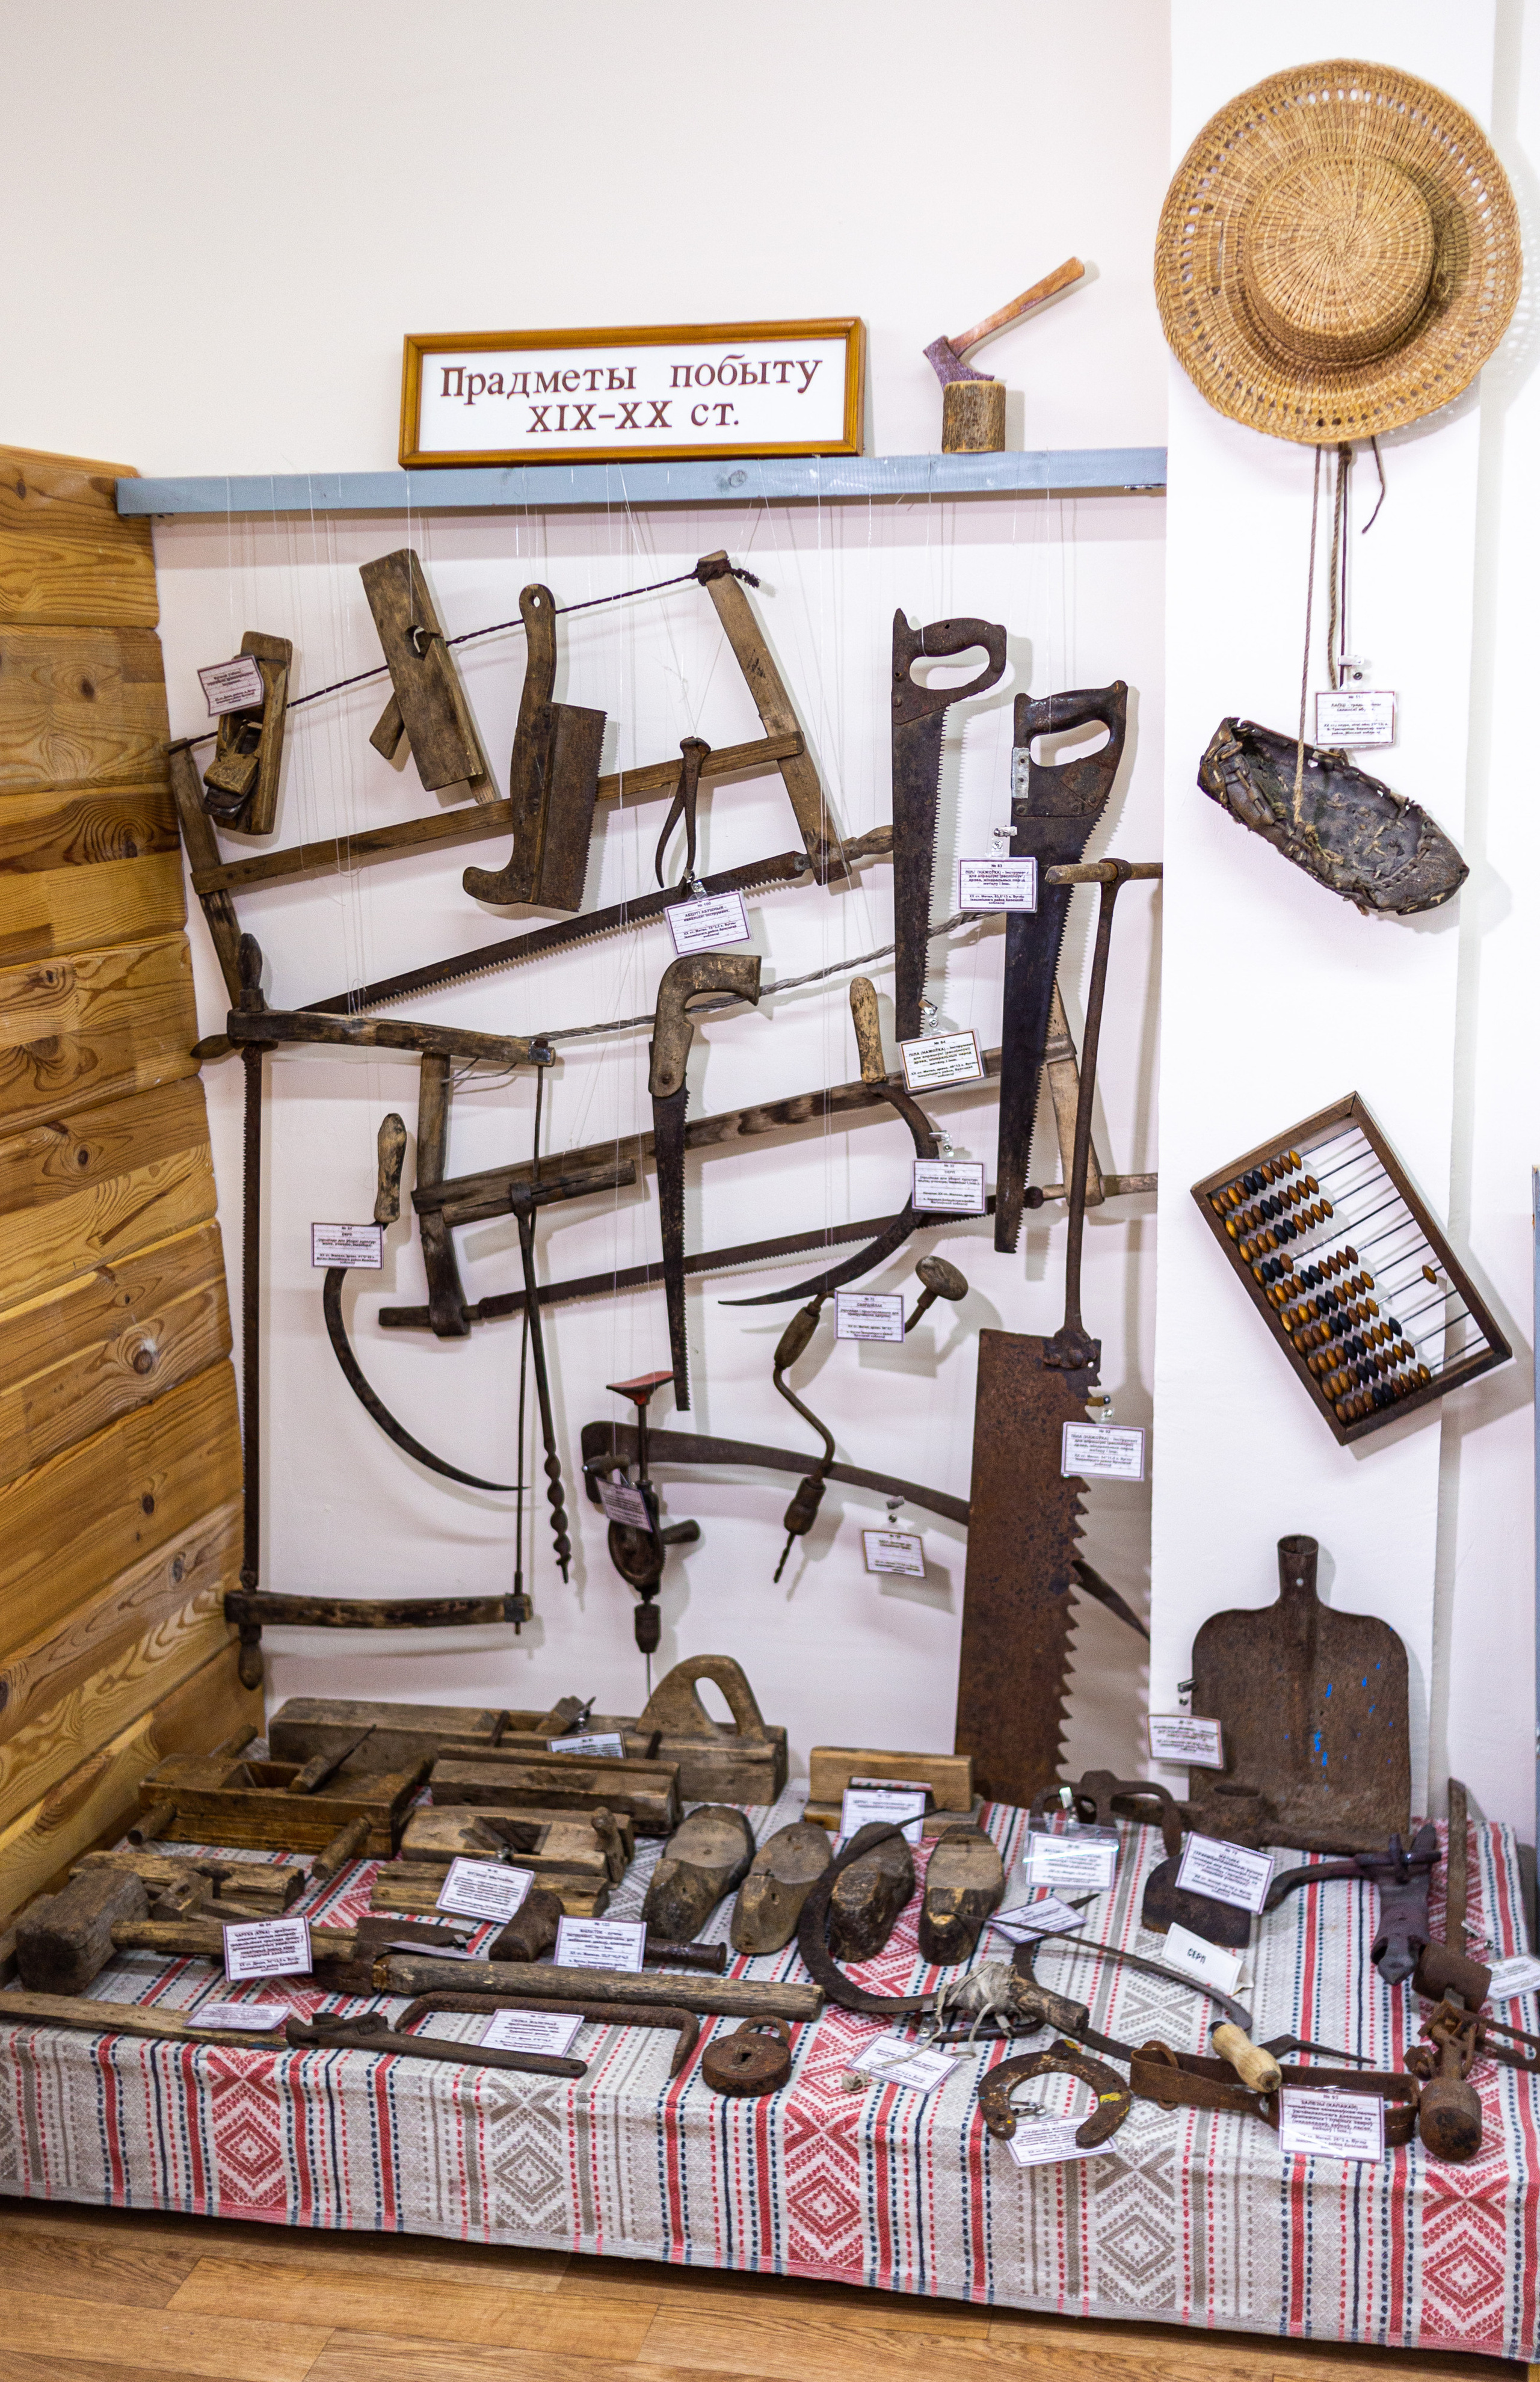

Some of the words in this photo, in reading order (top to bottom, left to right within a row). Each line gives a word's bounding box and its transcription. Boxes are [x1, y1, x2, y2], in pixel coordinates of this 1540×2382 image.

[440, 365, 637, 405] Прадметы
[669, 354, 823, 393] побыту
[690, 402, 739, 427] ст.
[1187, 1948, 1207, 1965] СЕРП
